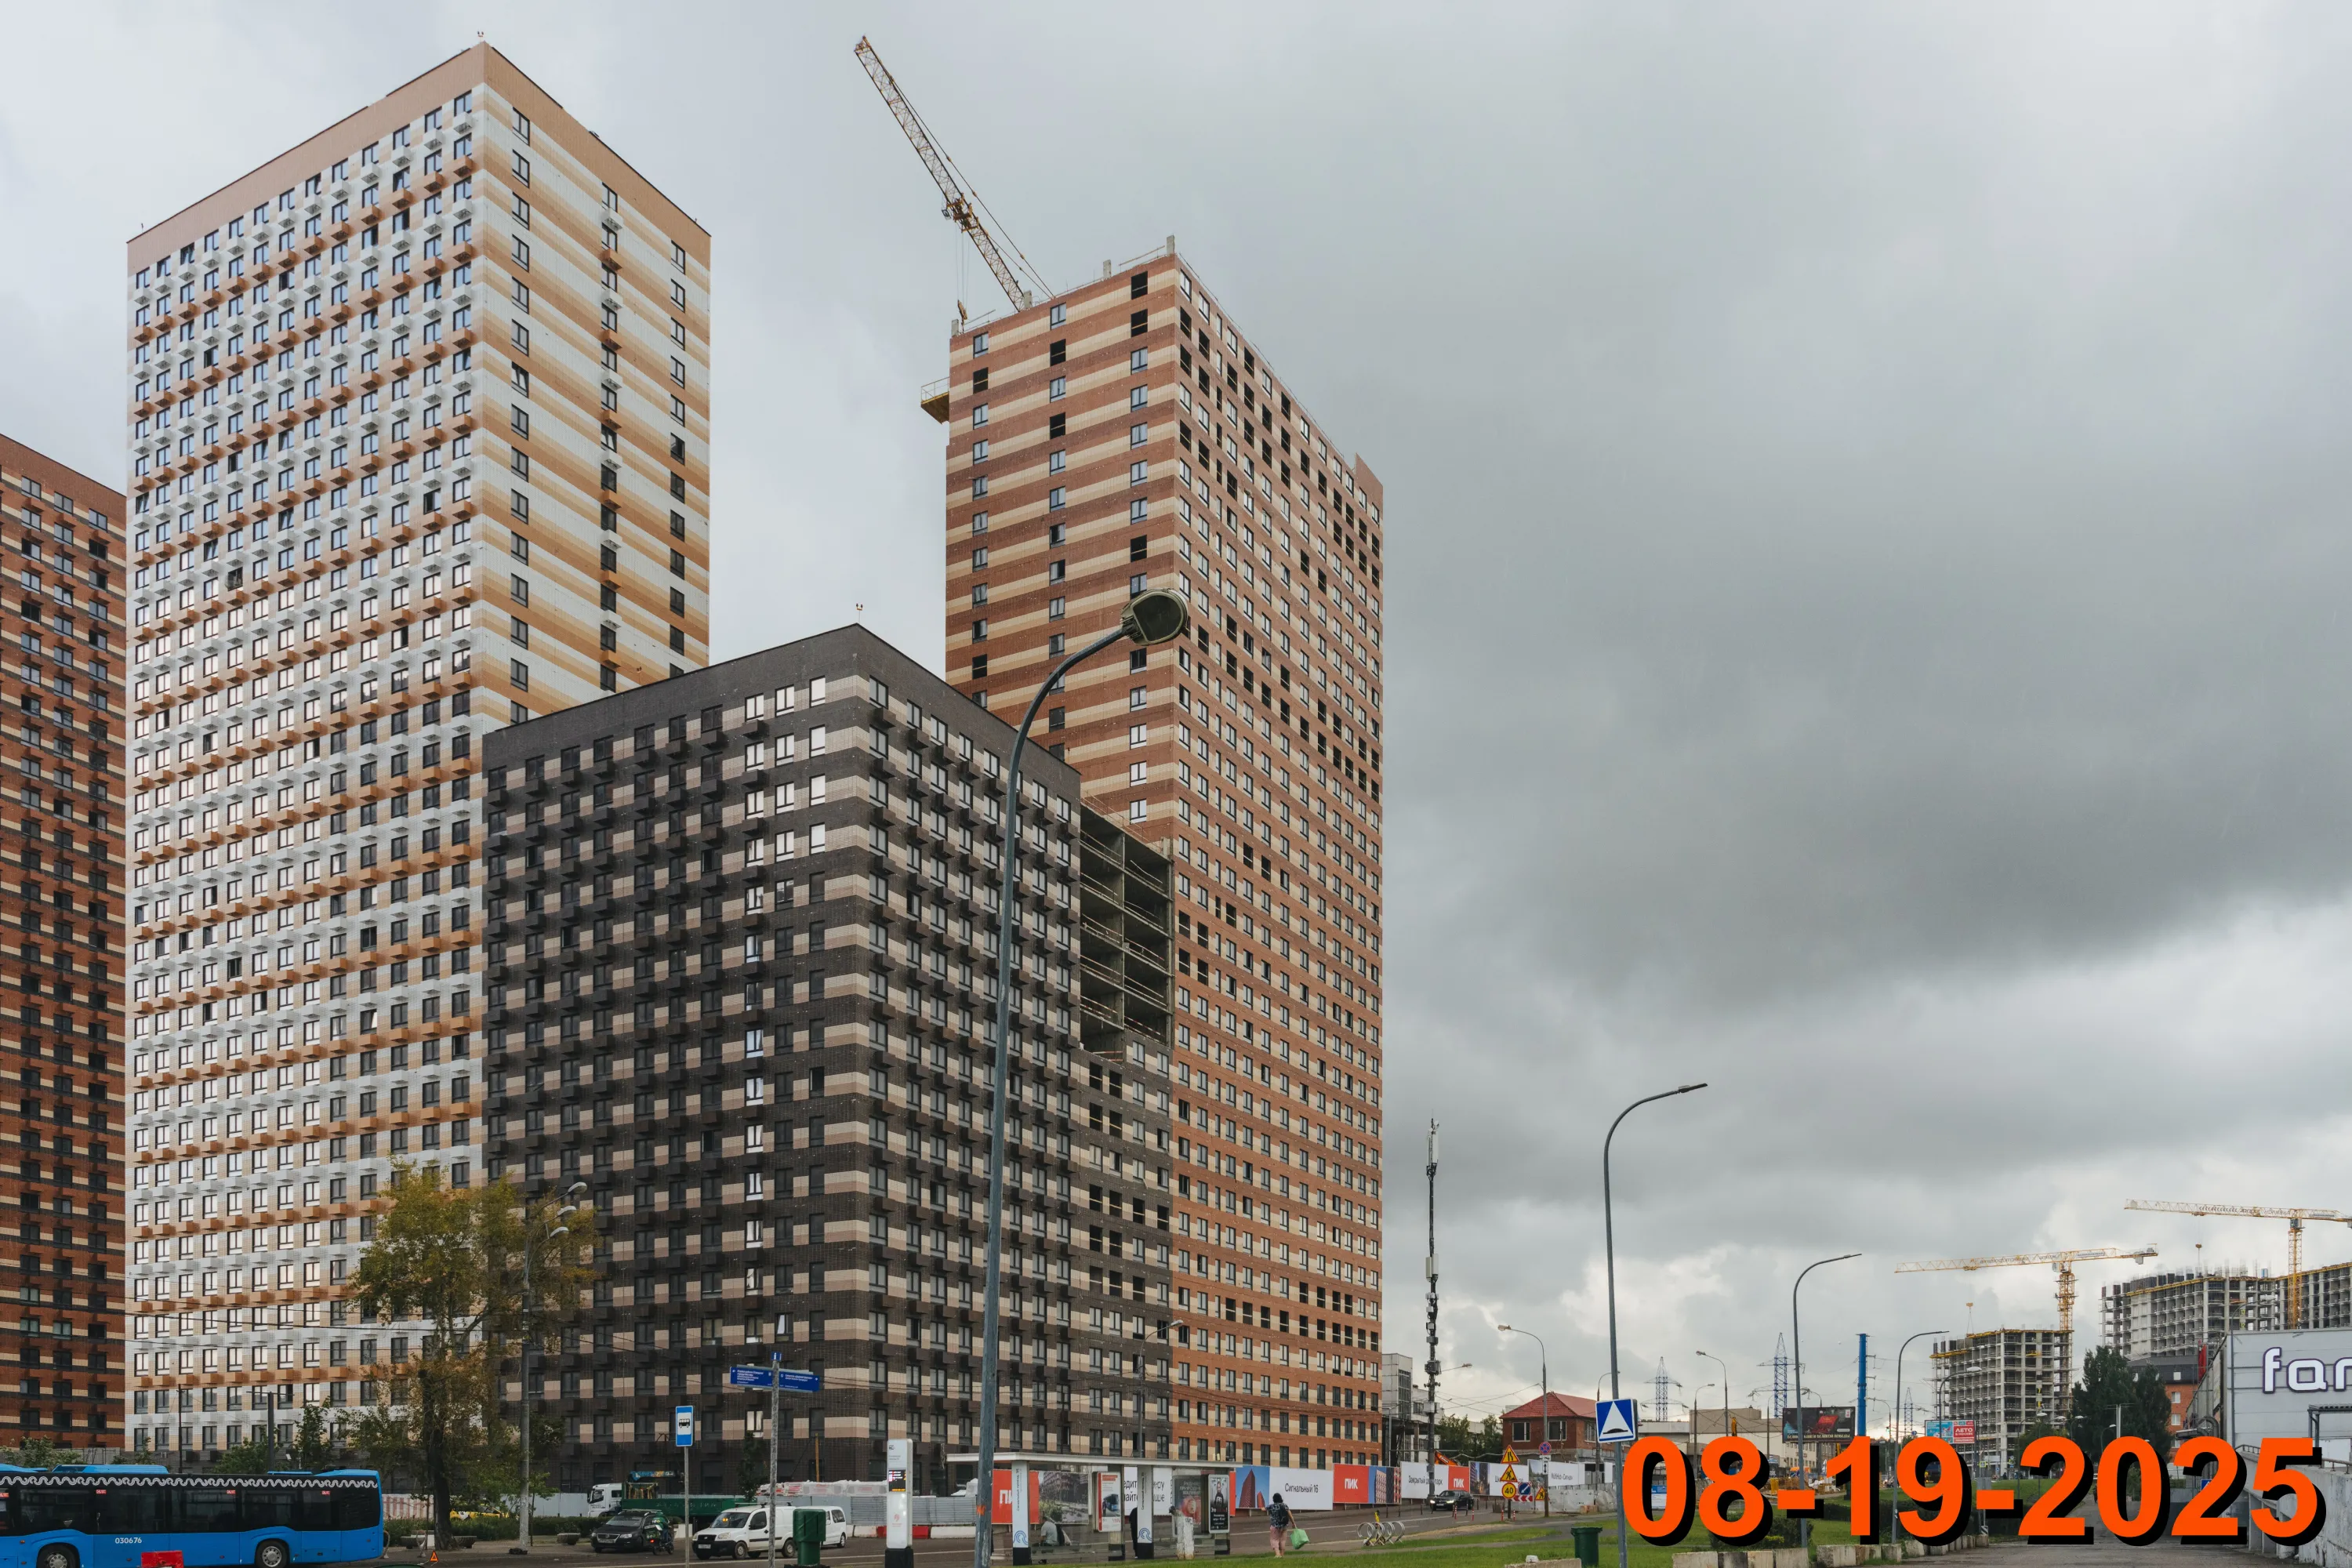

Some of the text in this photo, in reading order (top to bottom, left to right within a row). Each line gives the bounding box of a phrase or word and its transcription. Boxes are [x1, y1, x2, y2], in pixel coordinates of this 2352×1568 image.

[1285, 1483, 1319, 1494] Сигнальный 16
[1345, 1478, 1359, 1490] ПИК
[1454, 1478, 1465, 1488] ПИК
